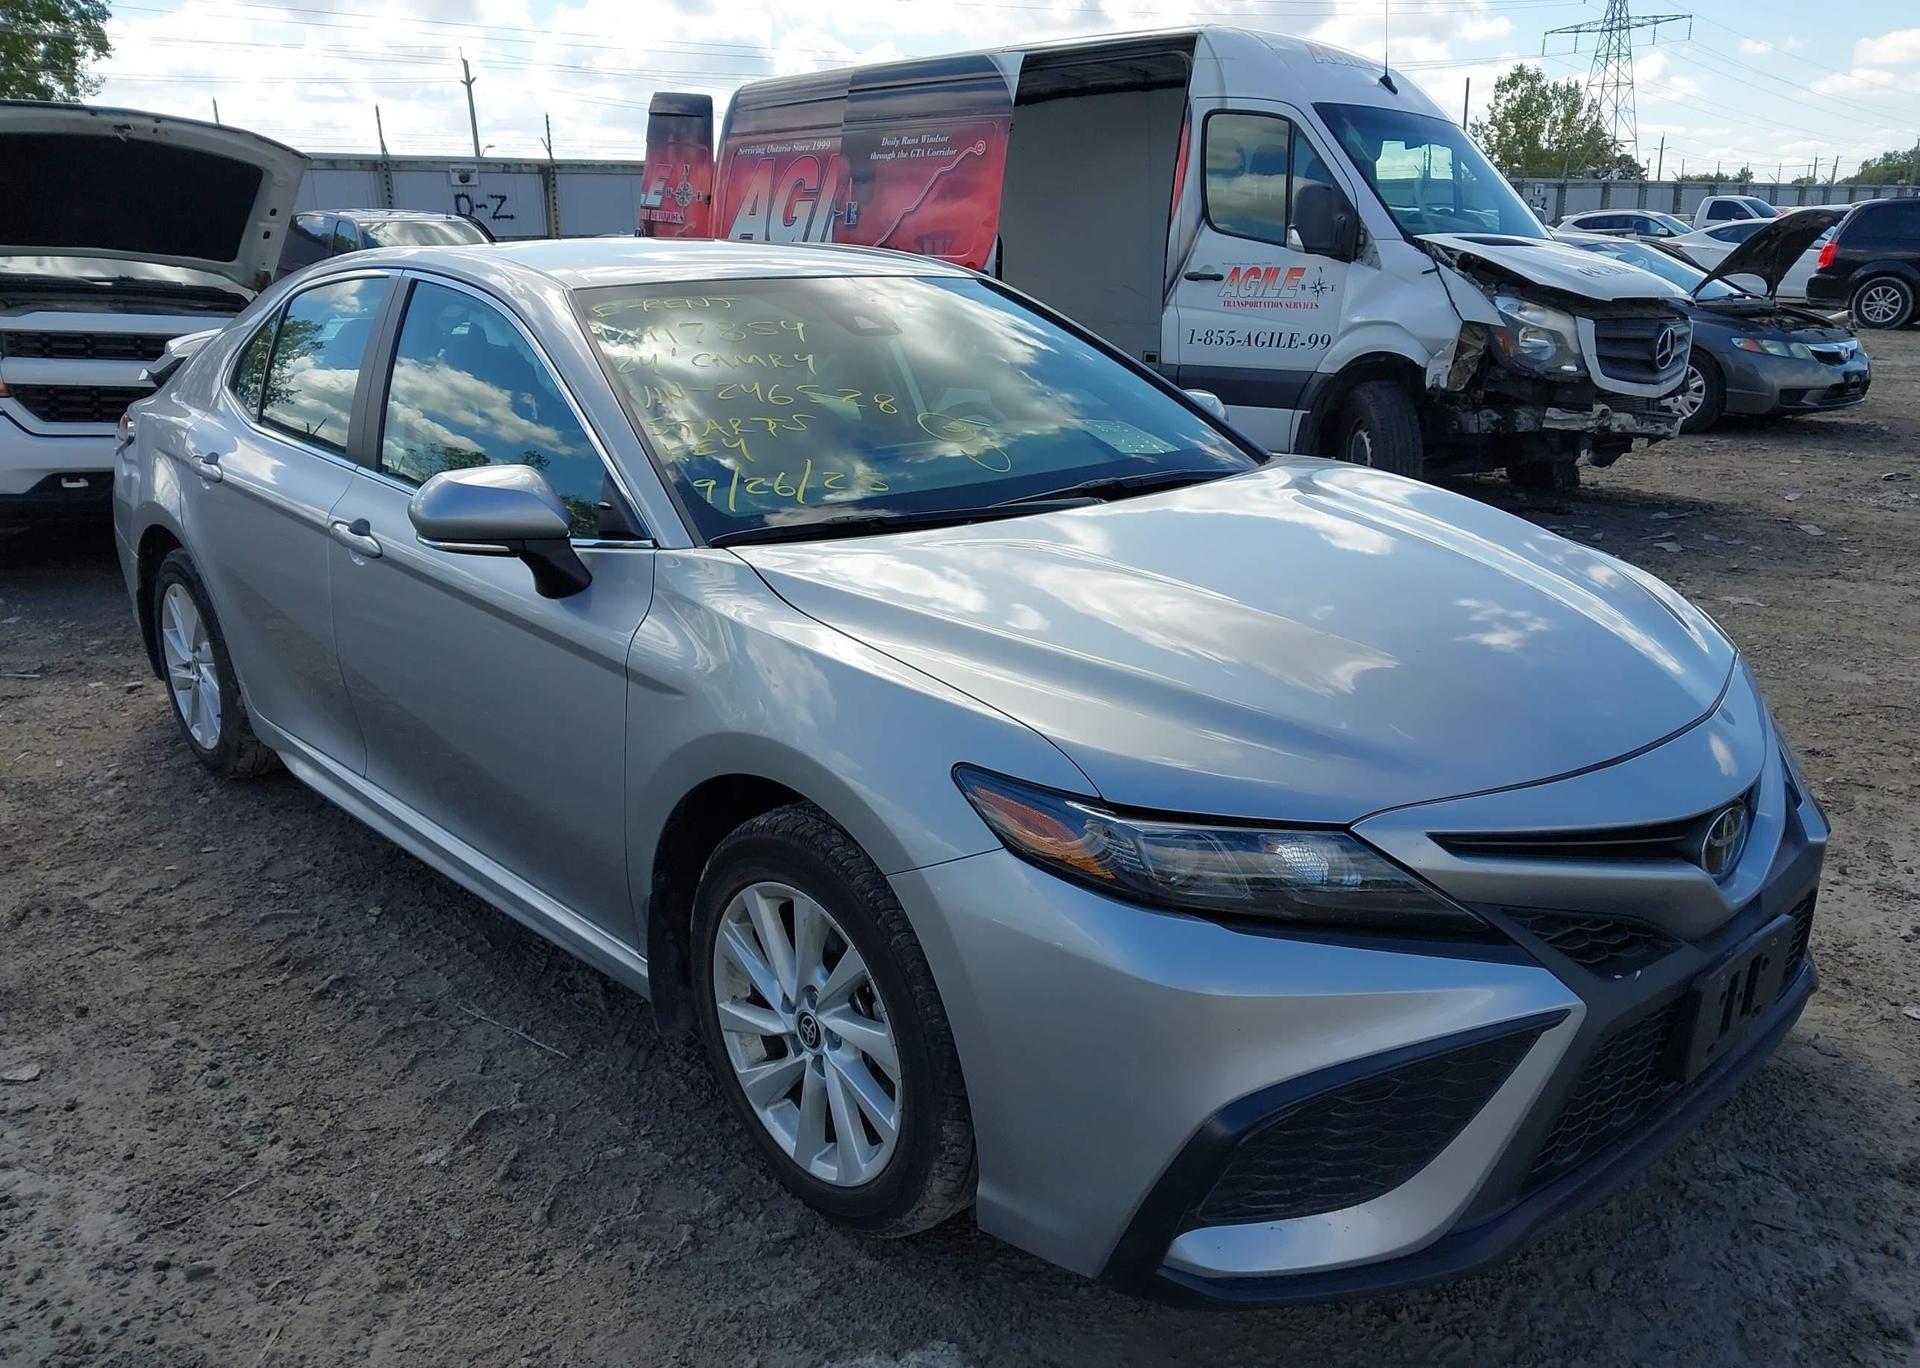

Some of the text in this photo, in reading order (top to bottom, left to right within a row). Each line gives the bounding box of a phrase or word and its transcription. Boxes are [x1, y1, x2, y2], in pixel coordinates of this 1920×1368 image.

[812, 140, 831, 150] 1999
[881, 133, 949, 147] Daily Runs Windsor
[870, 150, 896, 160] through
[897, 149, 909, 158] the
[927, 146, 957, 156] Corridor
[1217, 266, 1306, 299] AGILE
[1223, 300, 1319, 310] TRANSPORTATION SERVICES
[1187, 328, 1332, 351] 1-855-AGILE-99
[691, 352, 817, 376] CAMRY
